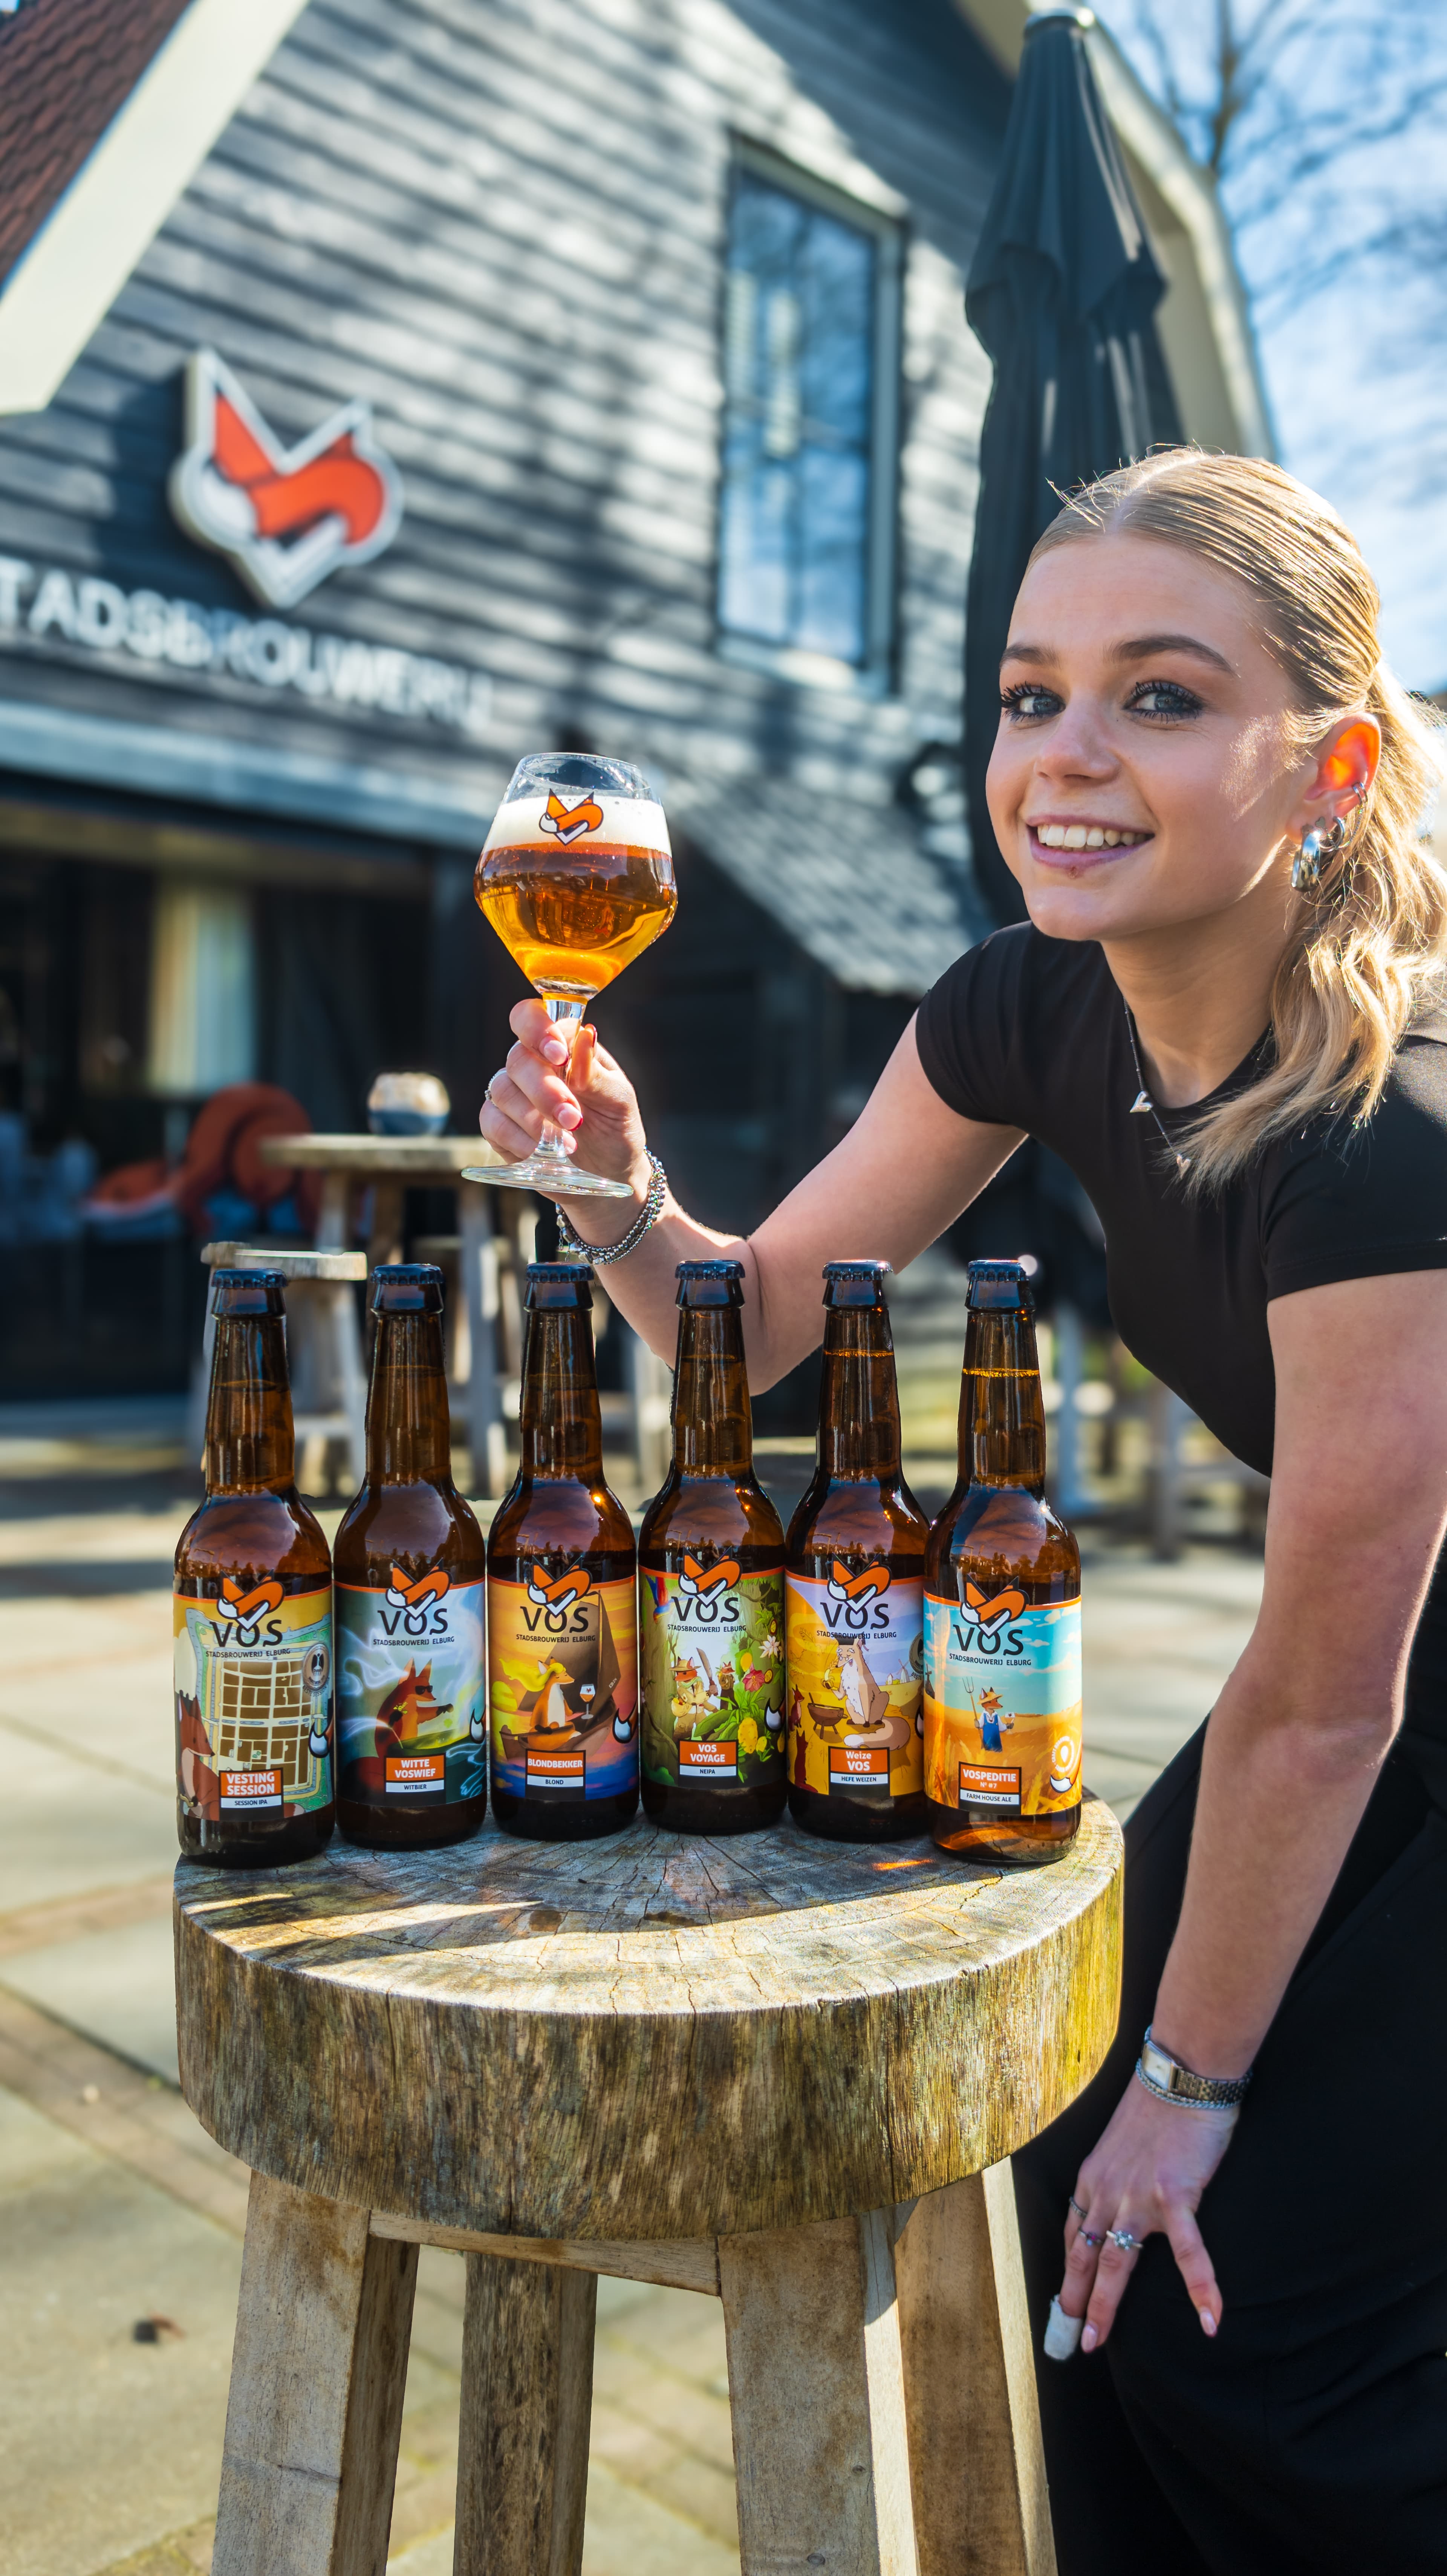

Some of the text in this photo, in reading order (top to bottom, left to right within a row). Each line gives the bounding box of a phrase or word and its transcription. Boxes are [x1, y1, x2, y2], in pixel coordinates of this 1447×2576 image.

[671, 1597, 739, 1623] VOS
[520, 1606, 588, 1633] VOS
[820, 1602, 889, 1629] VOS
[378, 1608, 448, 1635] VOS
[668, 1624, 720, 1632] STADSBROUWERIJ
[210, 1620, 283, 1647] VOS
[516, 1634, 569, 1642] STADSBROUWERIJ
[817, 1630, 870, 1639] STADSBROUWERIJ
[953, 1624, 1024, 1656] VOS
[949, 1653, 1003, 1665] STADSBROUWERIJ
[698, 1744, 717, 1753] VOS
[690, 1754, 725, 1762] VOYAGE
[846, 1751, 871, 1759] Weize
[401, 1759, 430, 1768] WITTE
[528, 1759, 583, 1768] BLONDBEKKER
[847, 1761, 870, 1771] VOS
[226, 1772, 274, 1784] VESTING
[395, 1768, 436, 1778] VOSWIEF
[963, 1769, 1016, 1782] VOSPEDITIE
[227, 1784, 274, 1795] SESSION
